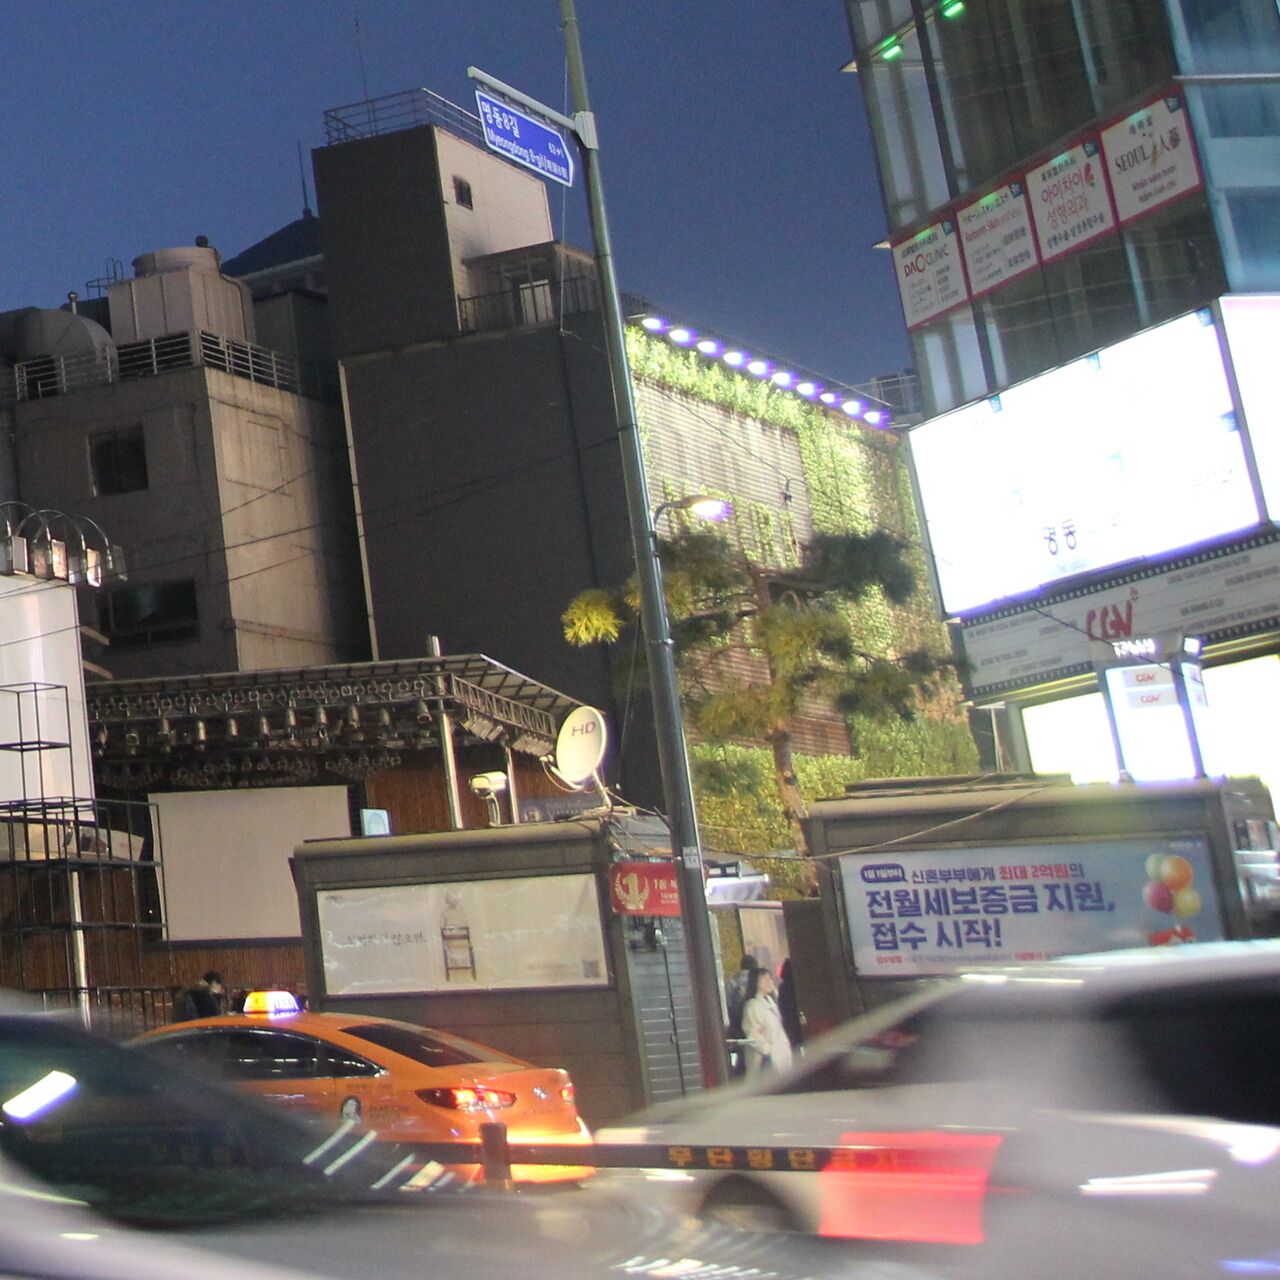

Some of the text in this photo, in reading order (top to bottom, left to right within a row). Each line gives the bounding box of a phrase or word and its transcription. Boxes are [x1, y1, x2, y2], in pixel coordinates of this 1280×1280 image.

[481, 101, 520, 138] 명동8길
[1114, 145, 1151, 174] SEOUL
[1086, 600, 1132, 640] CGV
[571, 720, 596, 737] HD
[912, 863, 1084, 884] 신혼부부에게 최대 2억원의
[865, 881, 1116, 919] 전월세보증금 지원,
[871, 917, 1002, 951] 접수 시작!
